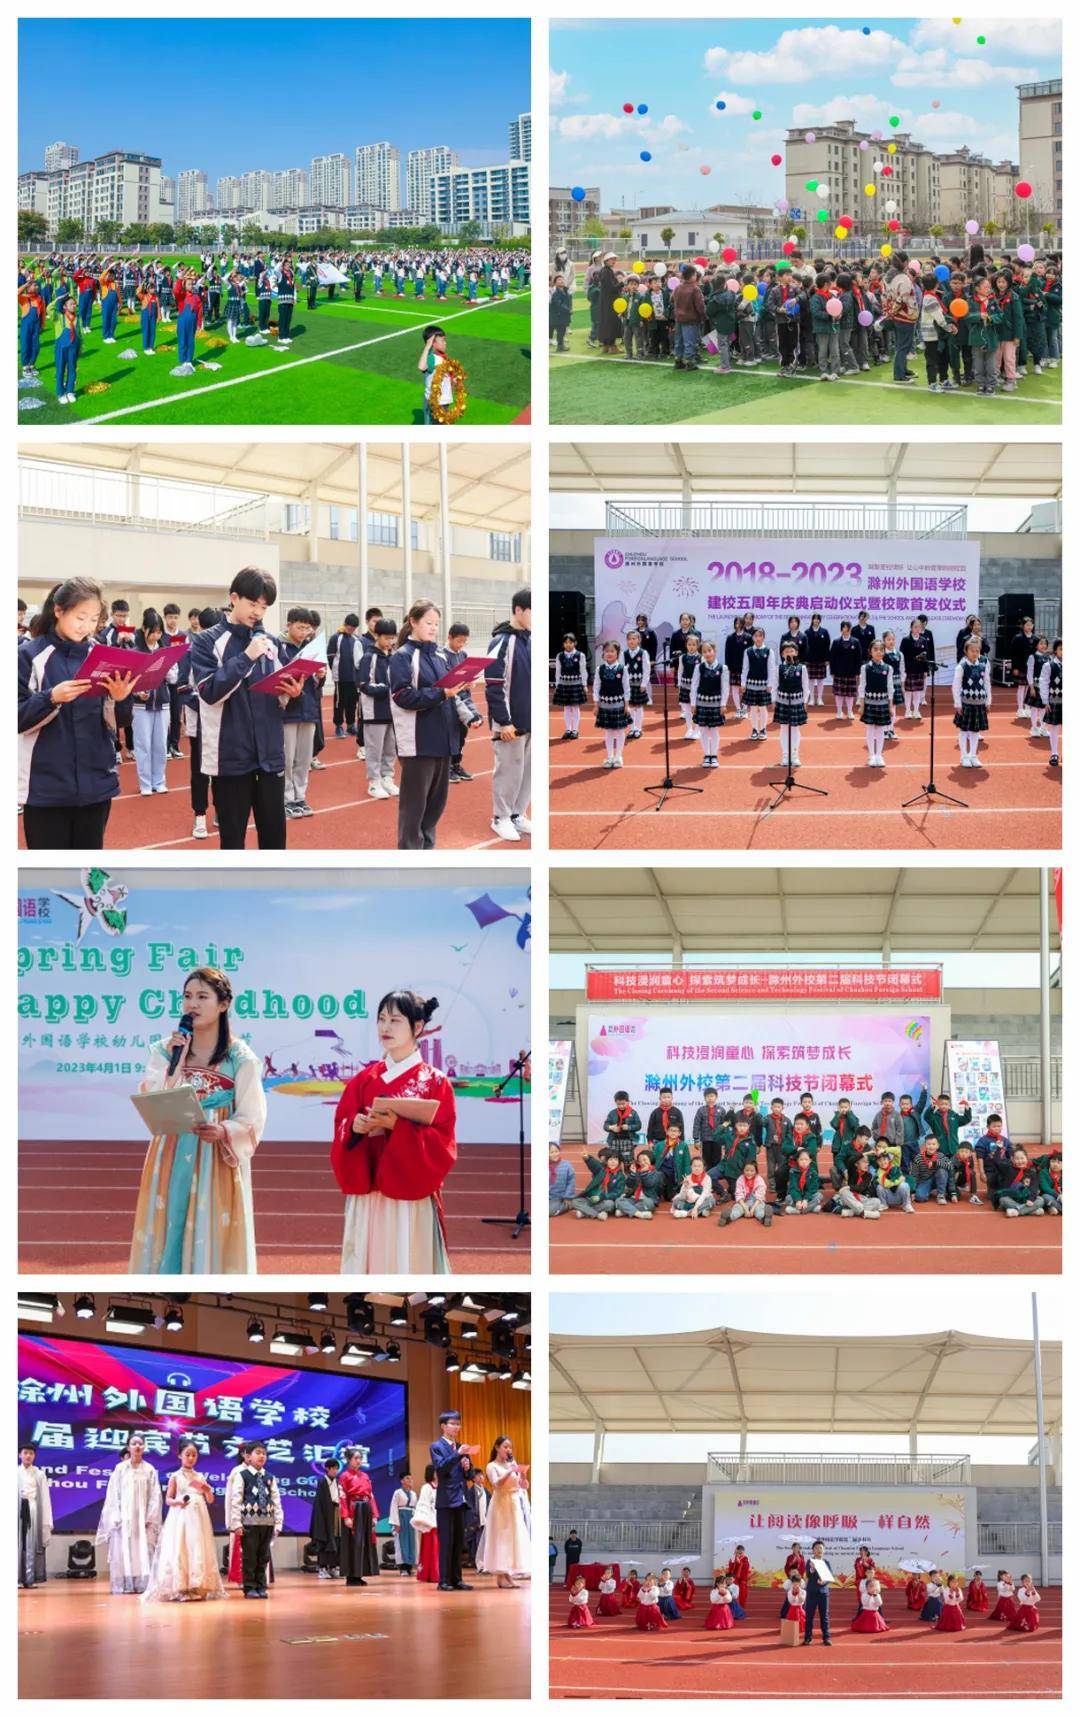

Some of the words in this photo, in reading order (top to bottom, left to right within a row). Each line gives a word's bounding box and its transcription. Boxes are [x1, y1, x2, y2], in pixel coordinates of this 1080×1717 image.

[707, 561, 863, 584] 2018-2023
[867, 576, 967, 591] 滁州外国语学校
[707, 595, 967, 611] 建校五周年庆典启动仪式暨校歌首发仪式
[147, 943, 244, 971] Fair
[139, 988, 369, 1020] Chdhood
[762, 1045, 852, 1061] 探索筑梦成长
[56, 1062, 132, 1073] 2023年4月1日
[644, 1073, 873, 1093] 滁州外校第二届科技节闭幕式
[749, 1514, 931, 1530] 让阅读像呼吸一样自然
